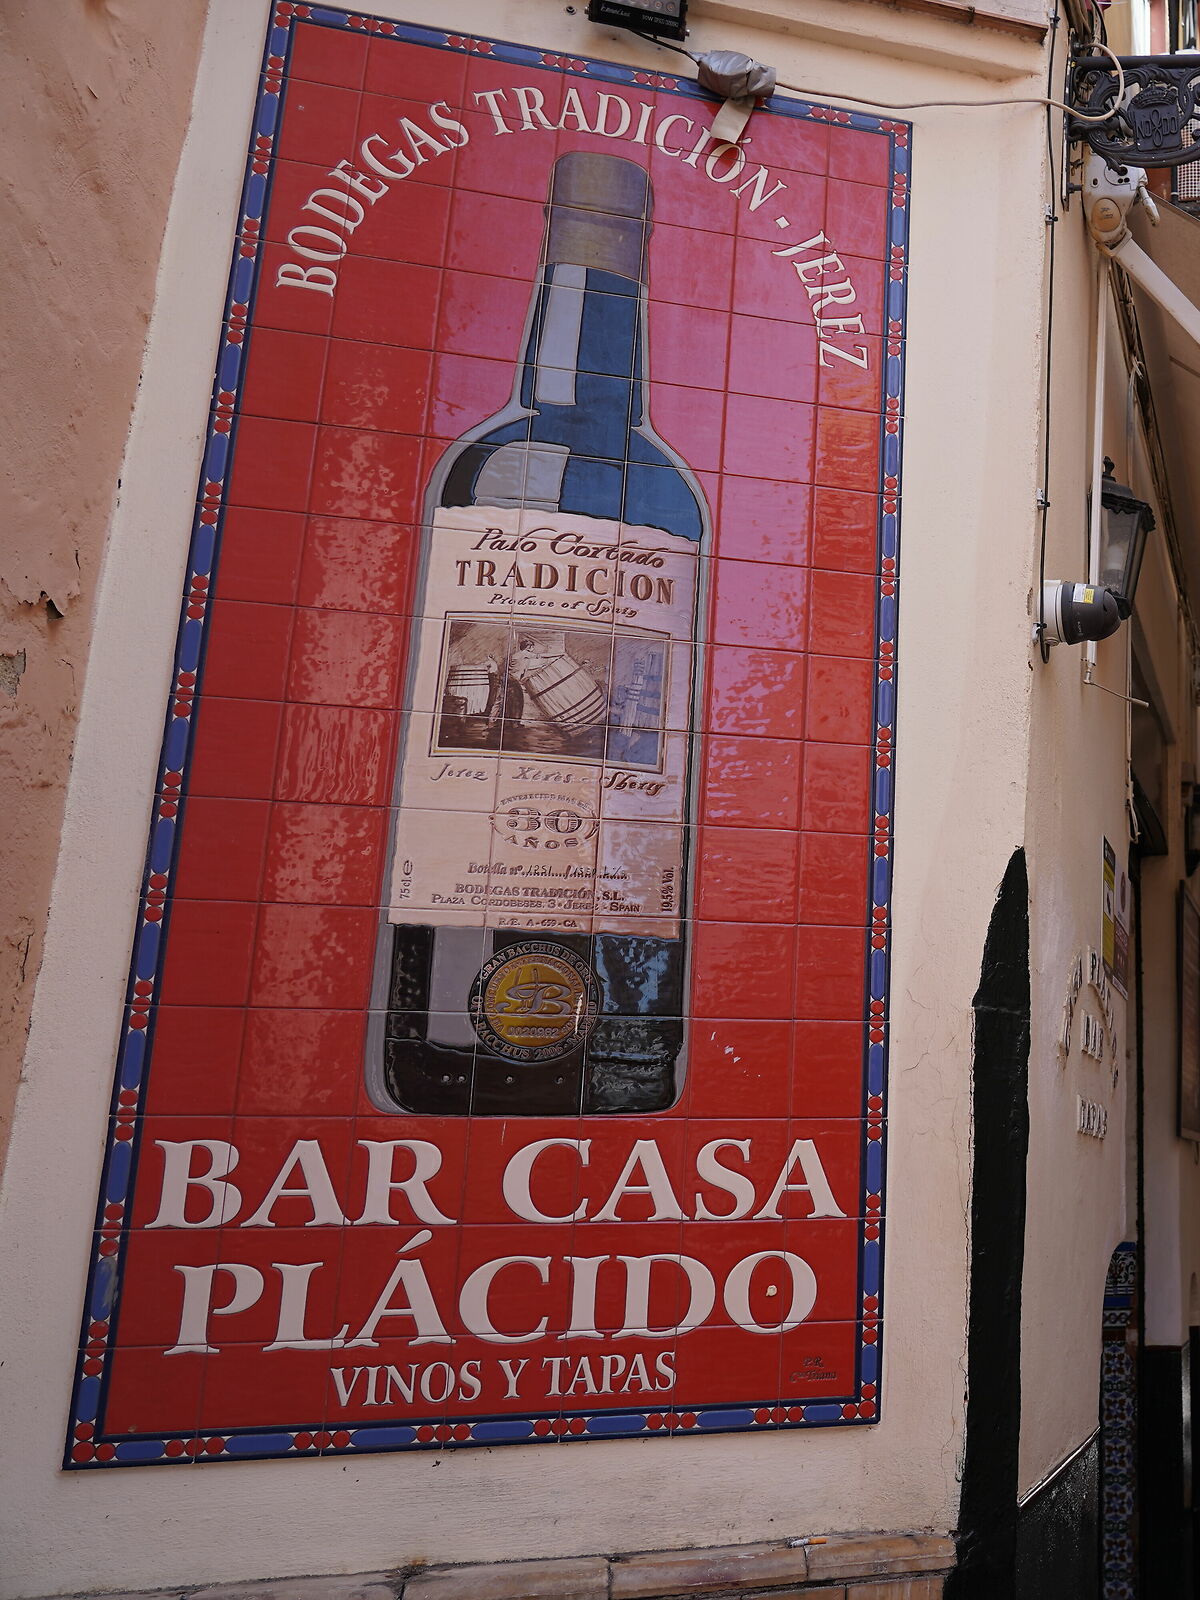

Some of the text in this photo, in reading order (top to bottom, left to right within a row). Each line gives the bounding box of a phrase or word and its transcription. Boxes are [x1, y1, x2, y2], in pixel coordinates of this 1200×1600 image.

[276, 86, 869, 371] BODEGAS TRADICIÓN JEREZ
[471, 527, 671, 569] Palo Cortado
[455, 559, 676, 607] TRADICION
[488, 592, 554, 608] Produce
[561, 600, 585, 611] of
[430, 762, 489, 782] Jerez
[600, 770, 667, 796] Sherry
[506, 806, 583, 834] 30
[504, 834, 578, 850] AÑOS
[467, 862, 508, 875] Botella
[455, 883, 519, 897] BODEGAS
[482, 952, 508, 980] GRAN
[507, 942, 562, 959] BACCHUS
[561, 949, 575, 964] DE
[477, 1020, 531, 1059] BACCHUS
[144, 1137, 848, 1230] BAR CASA
[163, 1229, 819, 1357] PLÁCIDO
[329, 1351, 677, 1407] VINOS Y TAPAS
